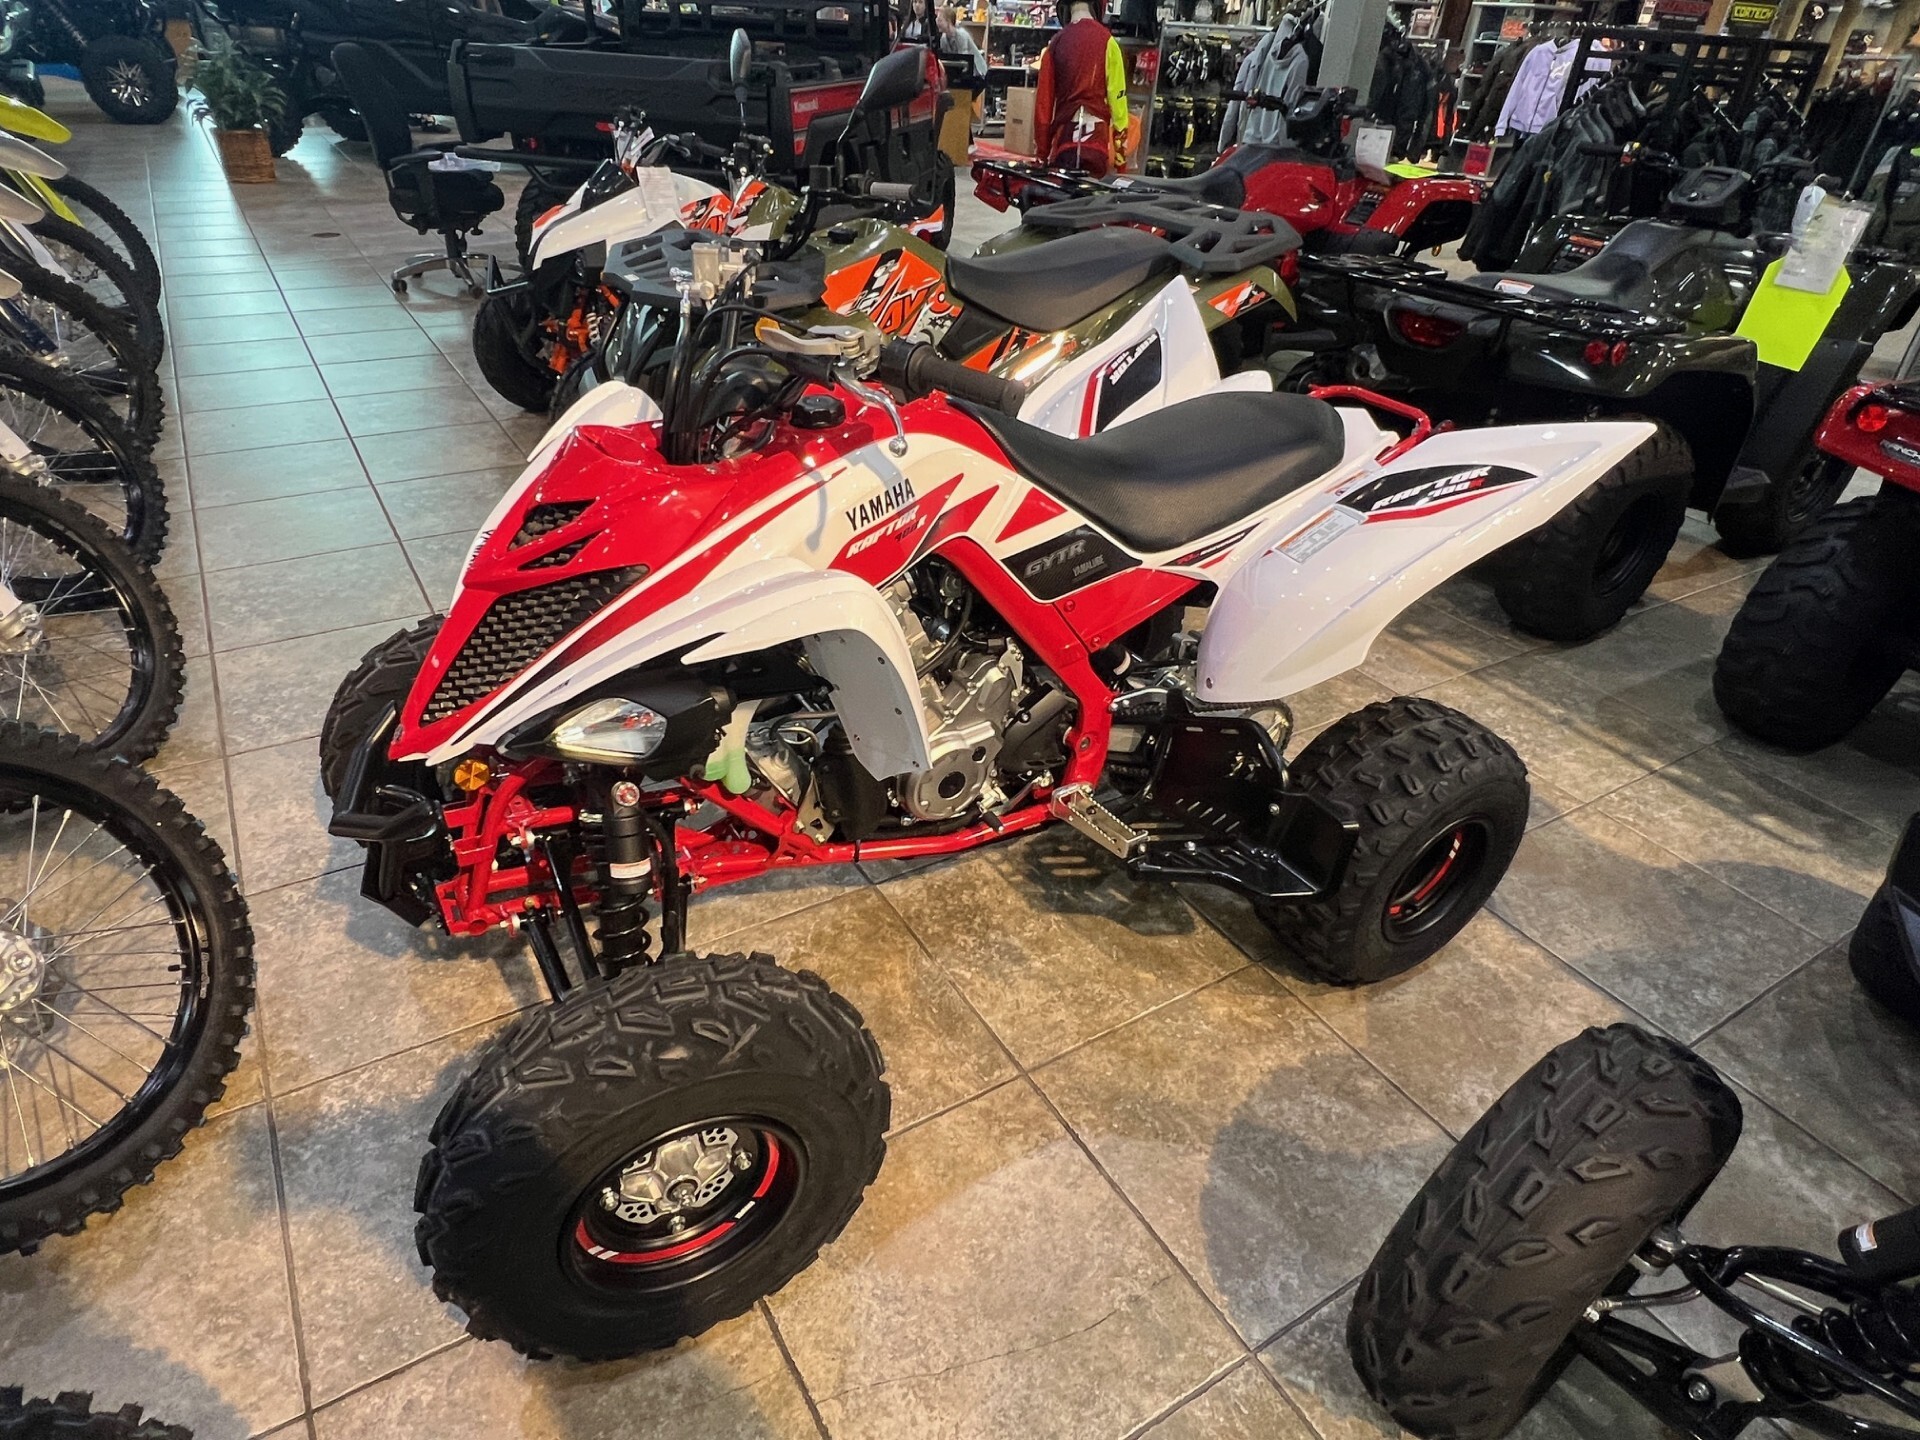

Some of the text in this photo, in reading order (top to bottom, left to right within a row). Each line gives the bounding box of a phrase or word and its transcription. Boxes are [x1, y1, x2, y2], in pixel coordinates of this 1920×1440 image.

[1734, 5, 1773, 19] CORTECH
[846, 478, 916, 531] YAMAHA
[1371, 466, 1492, 511] RAPTOR
[846, 505, 920, 558] RAPTOR
[1024, 539, 1087, 579] GYTR
